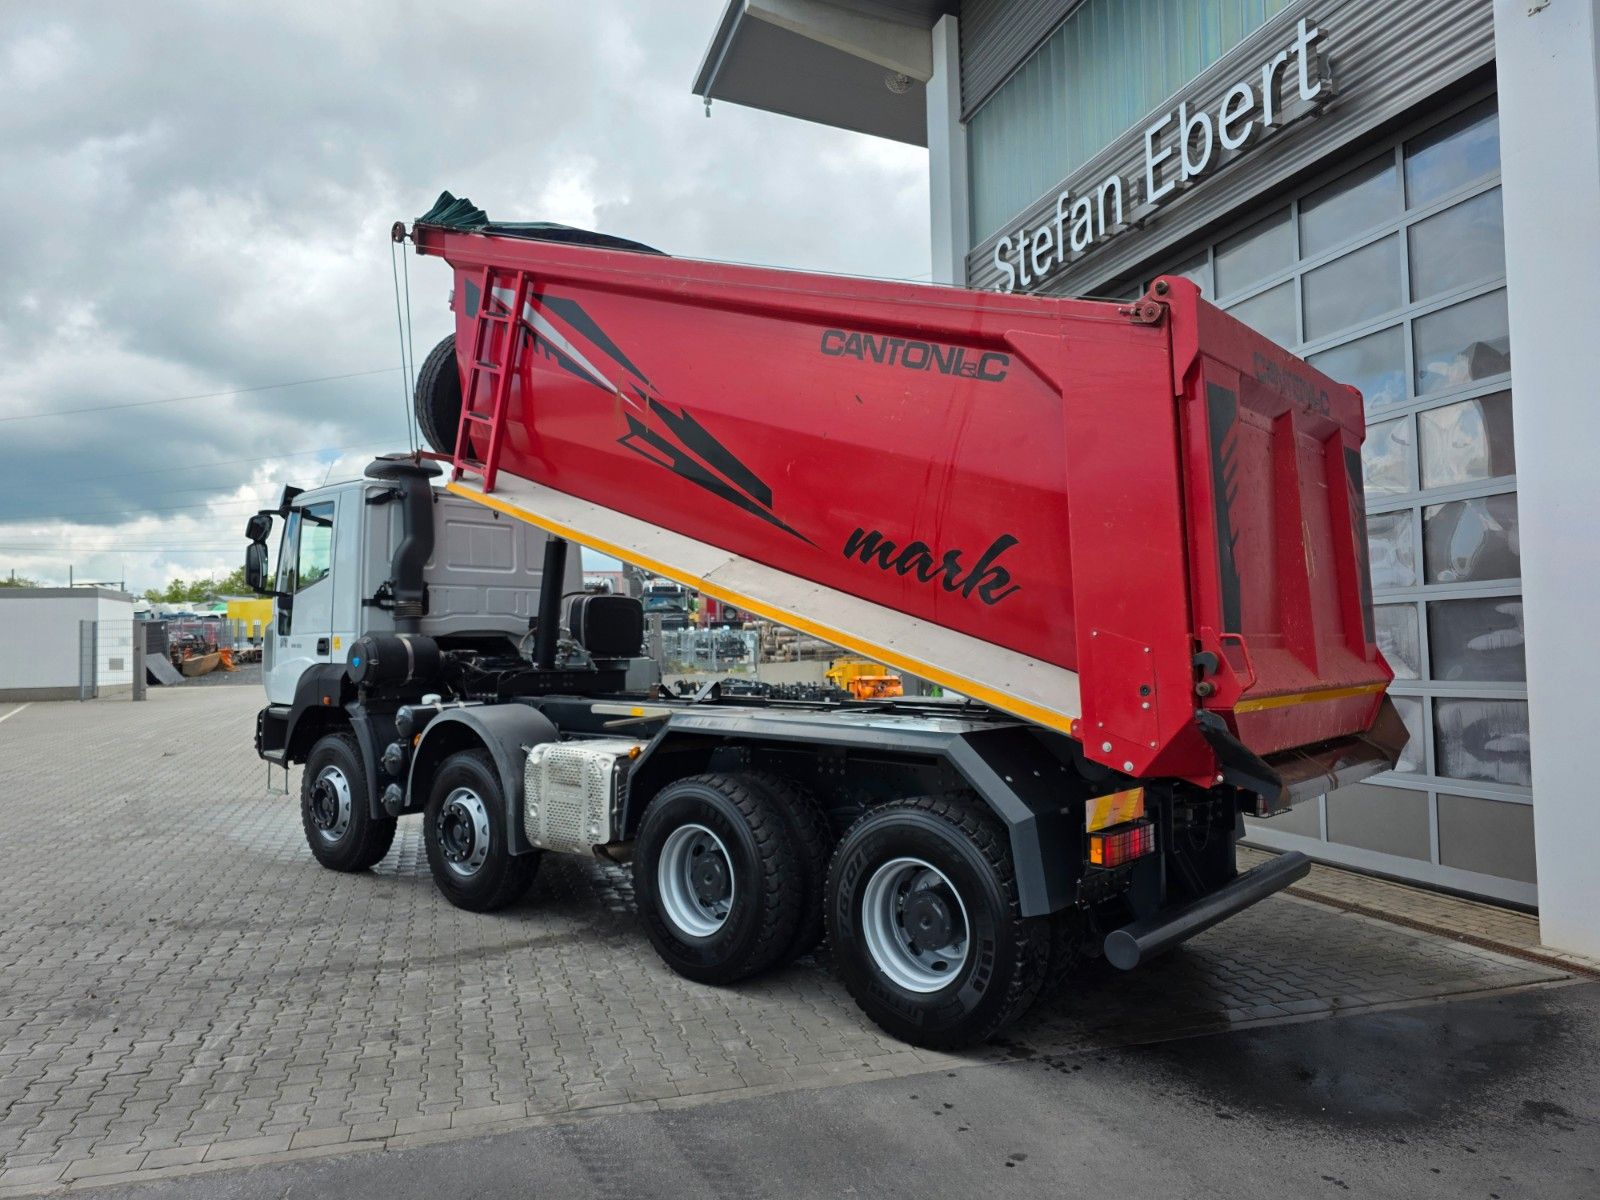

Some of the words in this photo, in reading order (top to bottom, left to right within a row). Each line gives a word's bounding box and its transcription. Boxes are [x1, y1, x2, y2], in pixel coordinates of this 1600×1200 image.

[994, 174, 1124, 294] Stefan
[1145, 17, 1322, 205] Ebert
[843, 528, 1022, 605] mark
